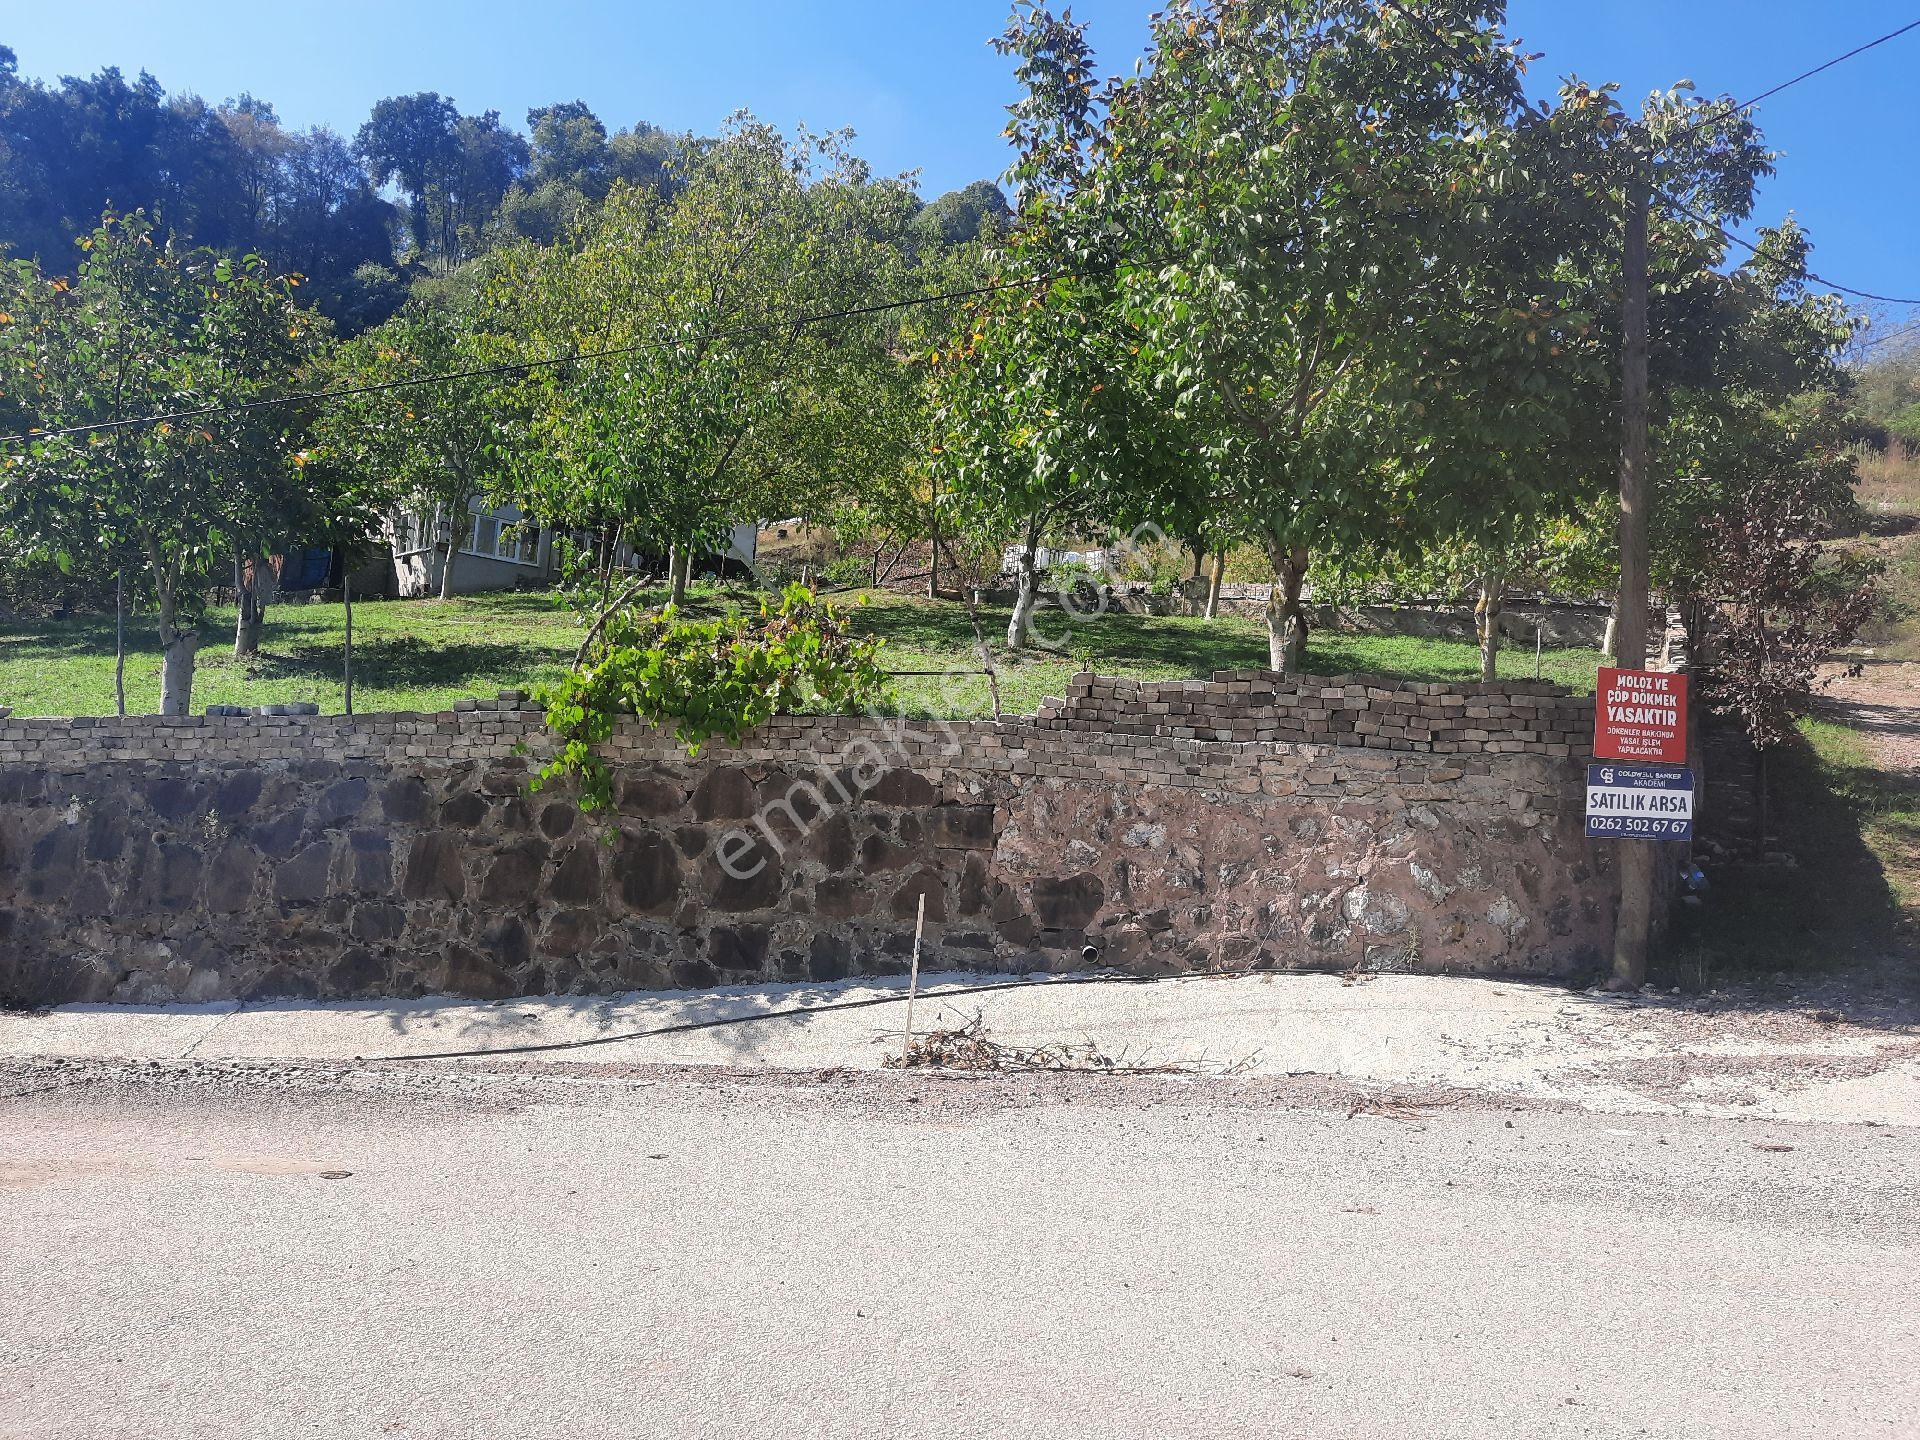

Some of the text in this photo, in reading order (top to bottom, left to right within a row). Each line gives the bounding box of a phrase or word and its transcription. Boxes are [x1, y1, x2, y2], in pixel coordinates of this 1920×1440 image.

[1617, 675, 1668, 690] MOLOZ VE
[1607, 687, 1677, 706] ÇÖP DÖKMEK
[1607, 706, 1677, 726] YASAKTIR
[1620, 737, 1640, 745] YASAL
[1618, 770, 1653, 778] COLDWELL
[1590, 792, 1687, 812] SATILIK ARSA
[1590, 817, 1687, 833] 0262 502 67 67
